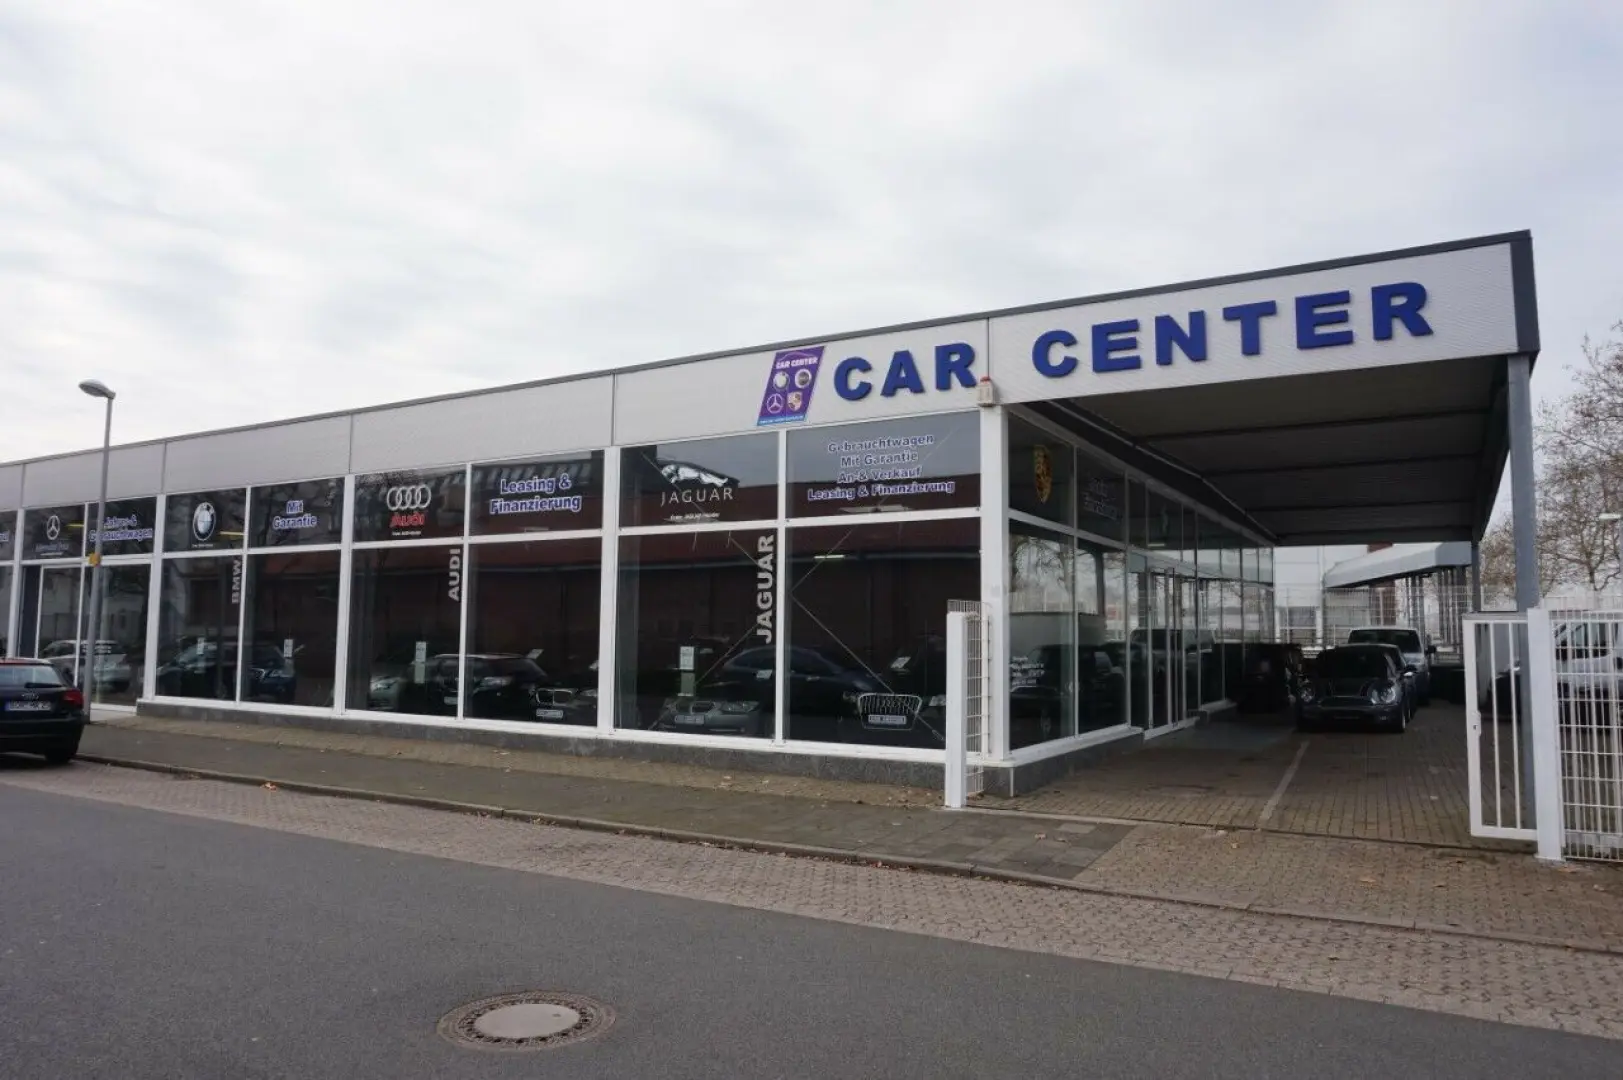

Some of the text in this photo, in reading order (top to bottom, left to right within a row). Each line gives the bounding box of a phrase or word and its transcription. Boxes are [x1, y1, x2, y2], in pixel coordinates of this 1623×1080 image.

[833, 281, 1434, 400] CAR CENTER
[775, 357, 818, 369] CAR CENTER
[828, 434, 935, 454] Gebrauchtwagen
[840, 450, 919, 468] Mit Garantie
[500, 473, 572, 494] Leasing &
[871, 466, 923, 481] Verkauf
[660, 487, 734, 507] JAGUAR
[807, 481, 956, 501] Leasing & Finanzierung
[286, 500, 304, 514] Mit
[489, 495, 582, 515] Finanzierung
[272, 514, 318, 530] Garantie
[231, 559, 242, 605] BMW
[448, 548, 461, 602] AUDI
[757, 535, 774, 644] JAGUAR
